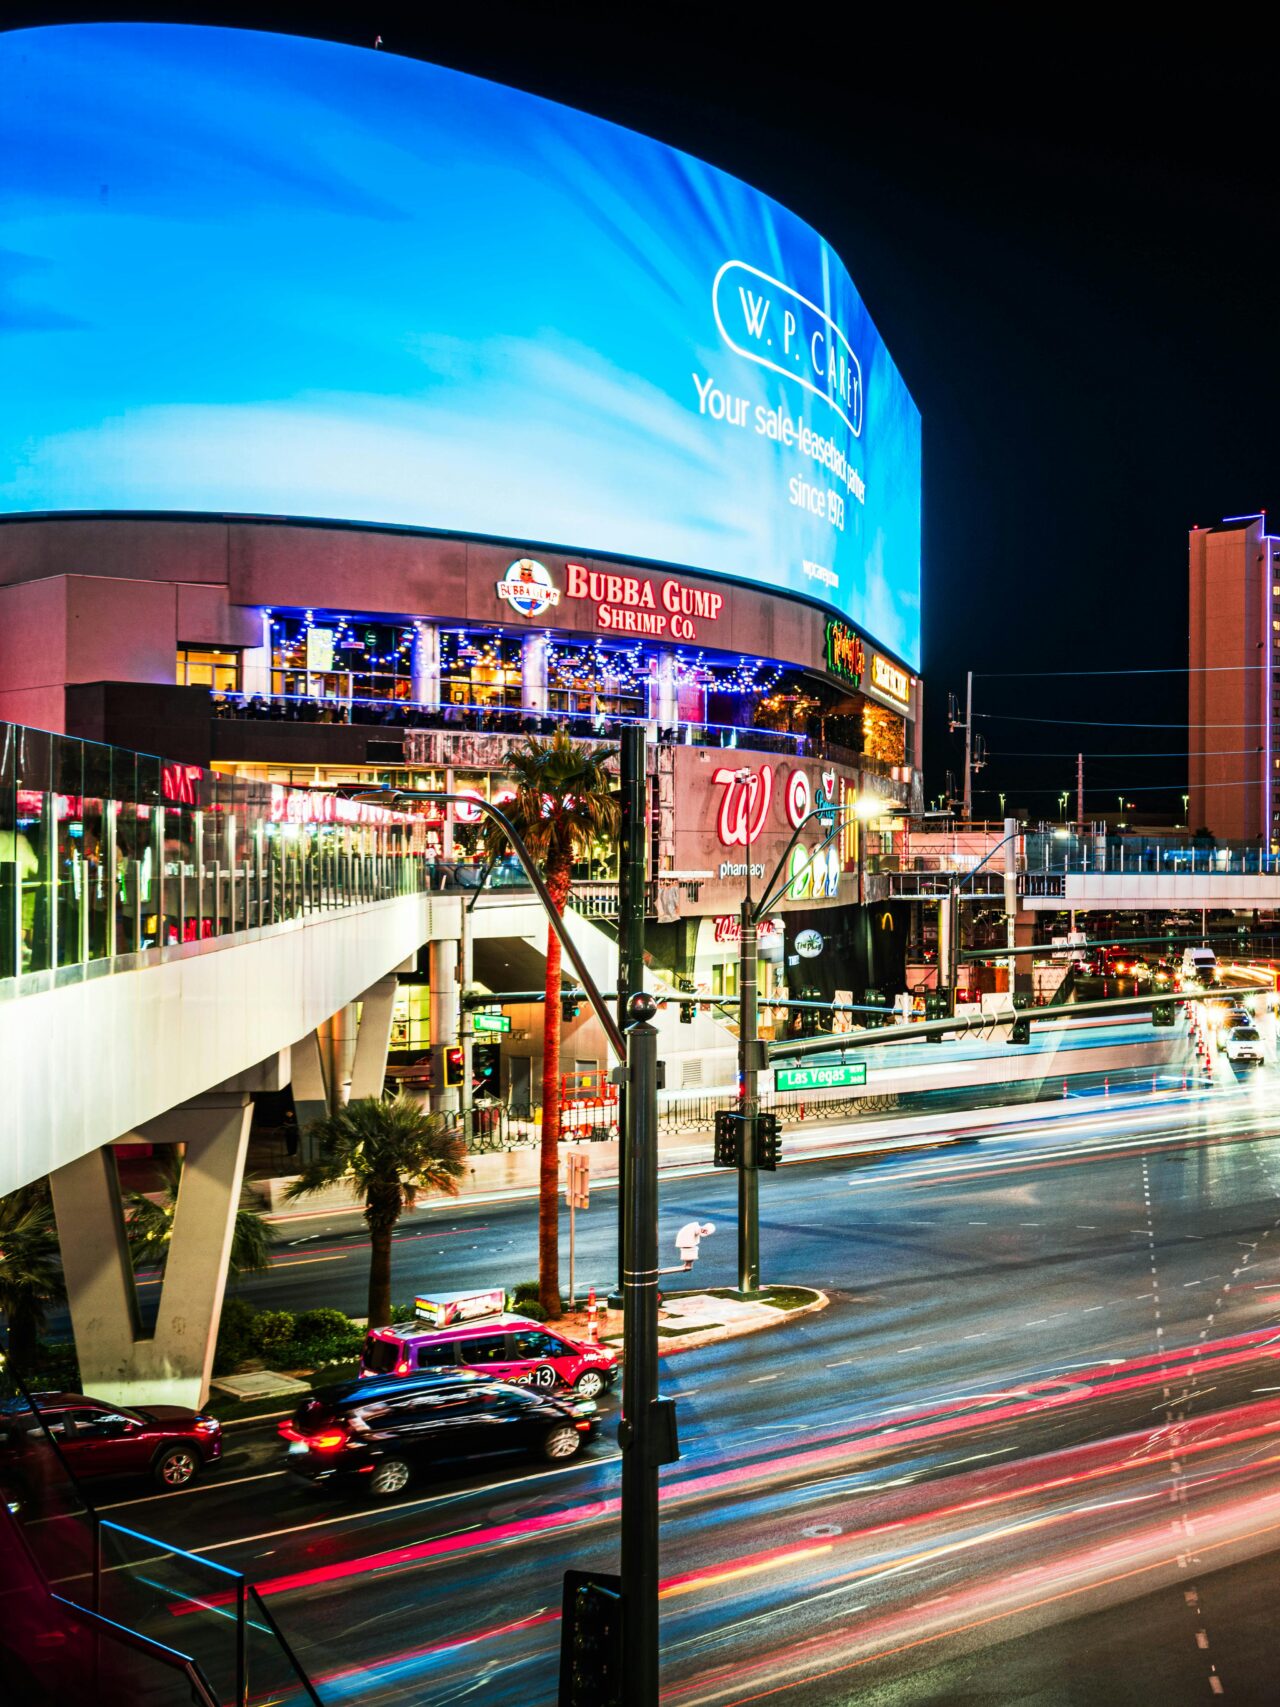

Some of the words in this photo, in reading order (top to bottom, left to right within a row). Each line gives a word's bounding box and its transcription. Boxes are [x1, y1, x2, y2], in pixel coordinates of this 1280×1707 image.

[811, 330, 858, 417] CAREY
[691, 372, 750, 427] Your
[754, 405, 847, 484] sale-leaseback
[788, 473, 826, 518] since
[826, 488, 845, 532] 1973
[565, 563, 657, 609] BUBBA
[661, 579, 723, 620] GUMP
[597, 603, 667, 636] SHRIMP
[719, 860, 766, 879] pharmacy
[786, 1070, 809, 1085] Las
[810, 1067, 845, 1087] Vegas
[535, 1369, 551, 1387] 13
